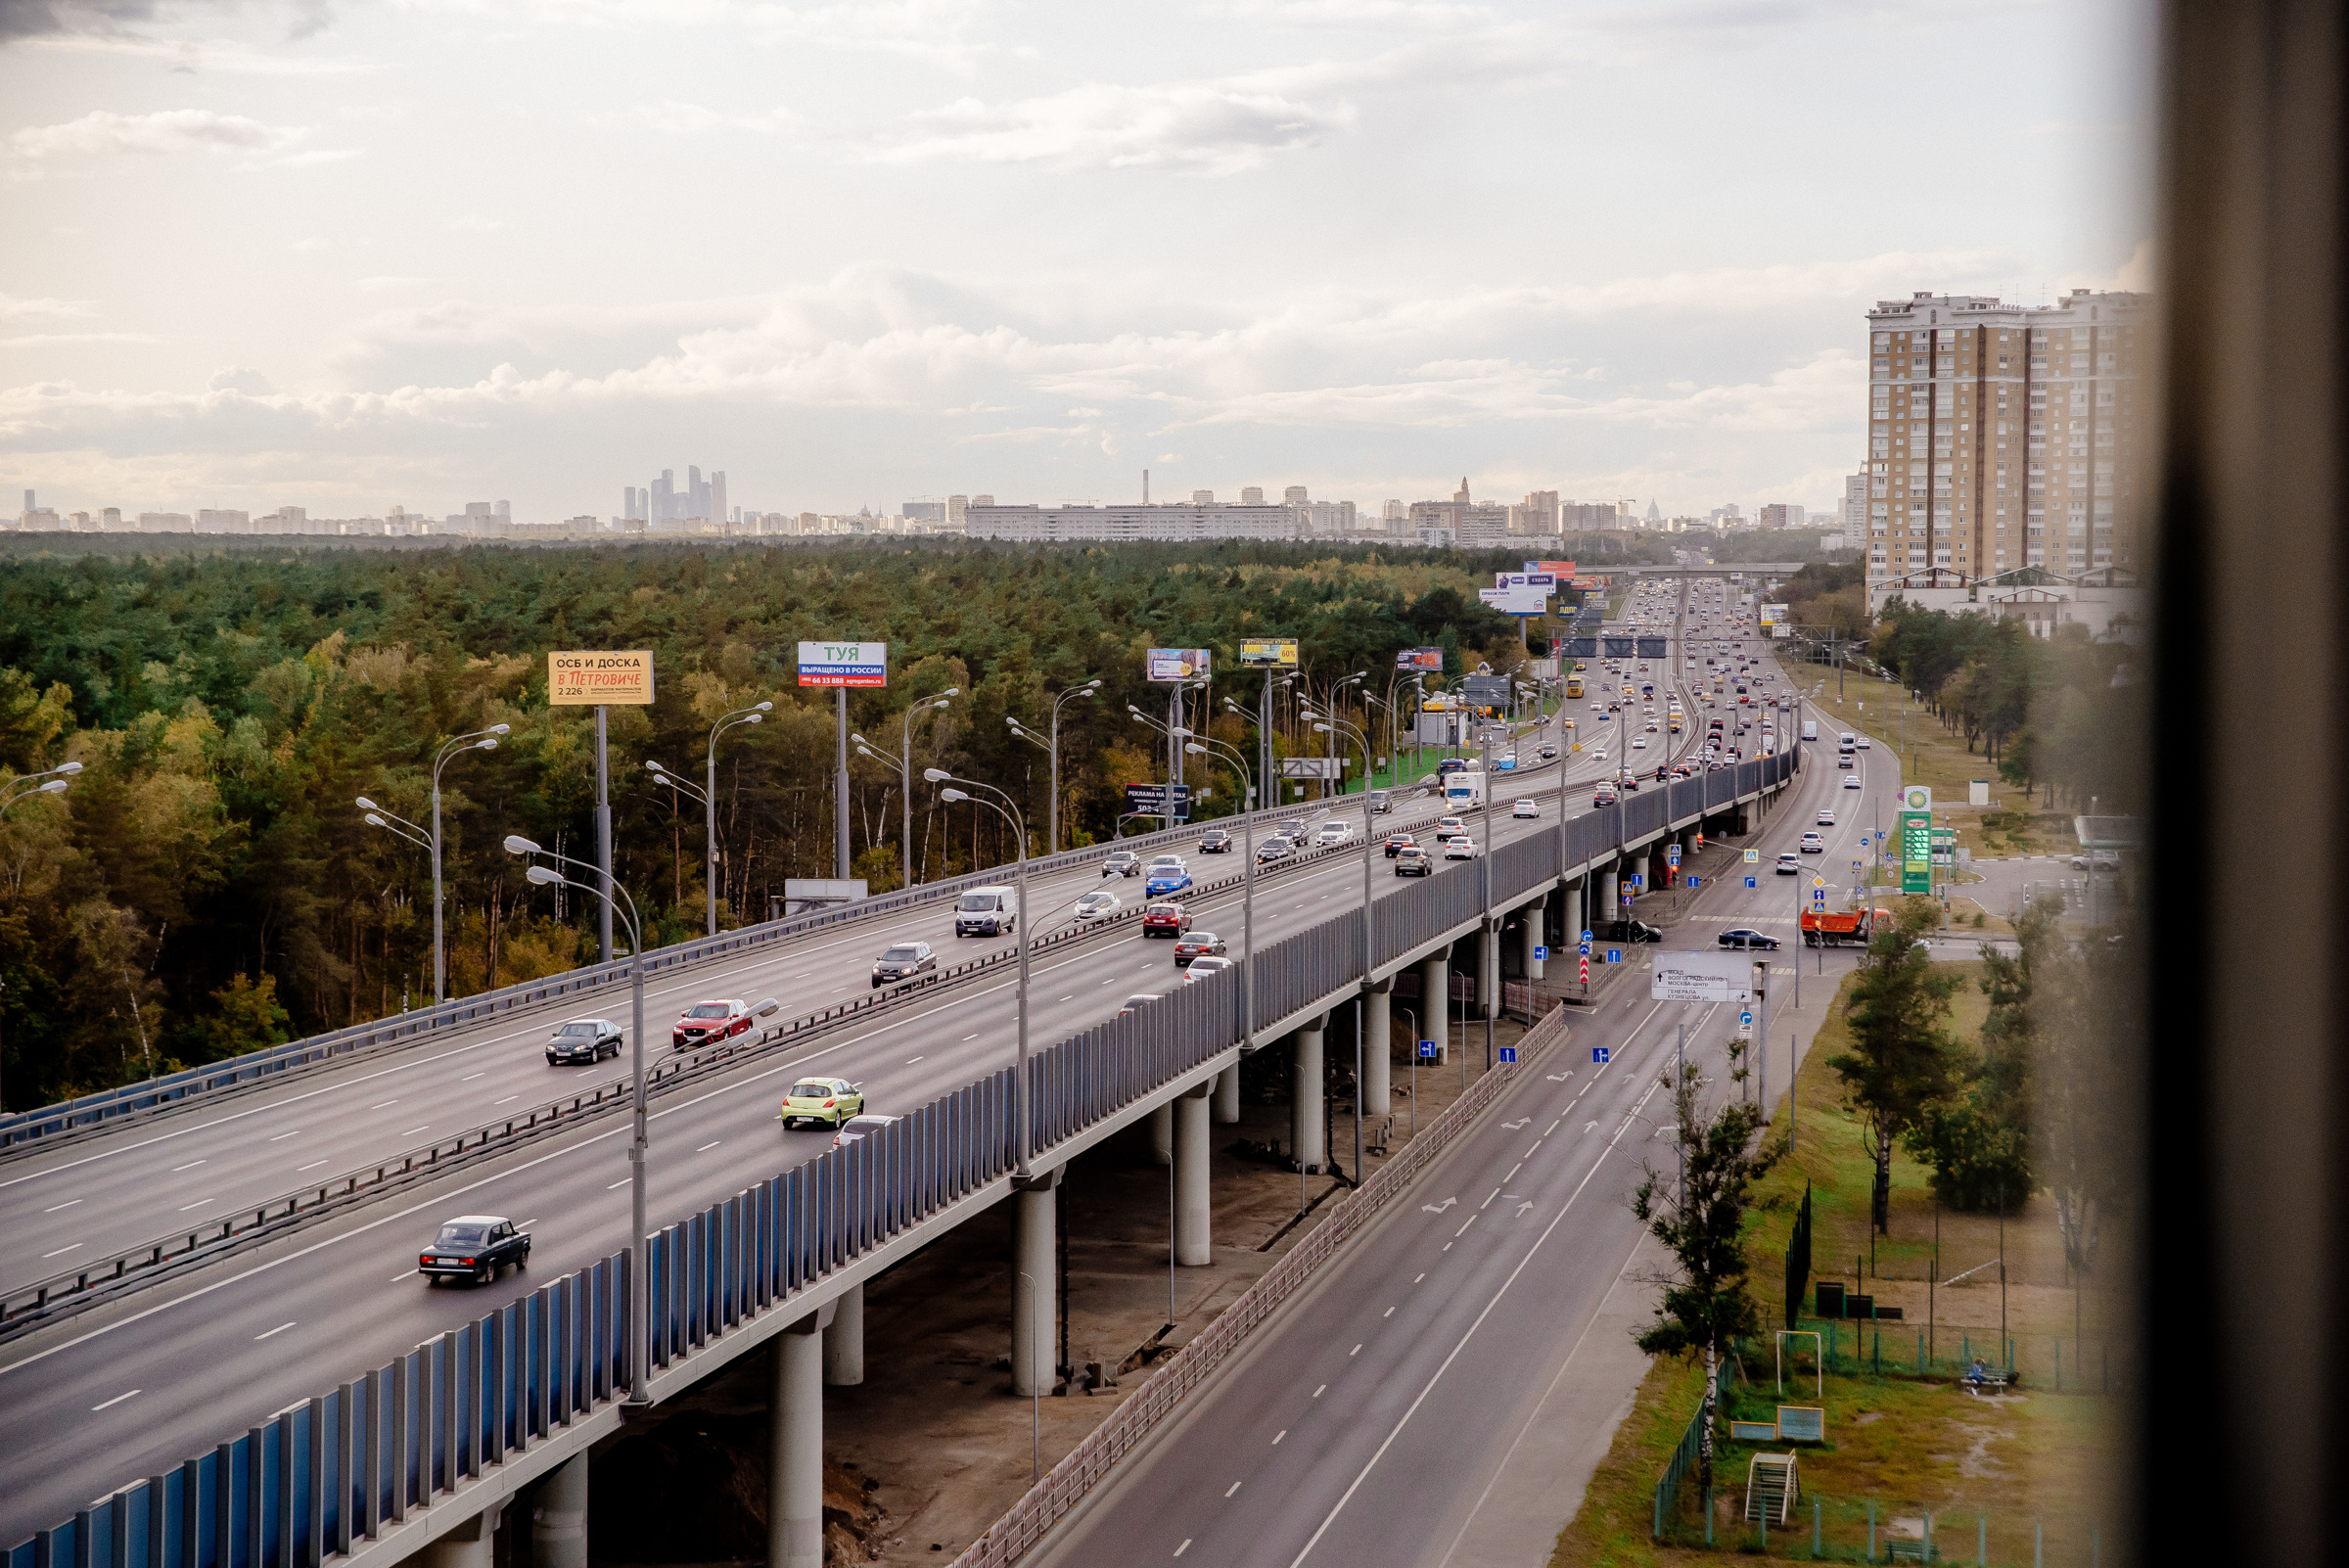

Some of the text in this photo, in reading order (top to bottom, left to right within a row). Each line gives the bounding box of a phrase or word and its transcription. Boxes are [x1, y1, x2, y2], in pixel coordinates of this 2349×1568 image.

[824, 647, 859, 662] ТУЯ
[557, 659, 641, 669] ОСБ И ДОСКА
